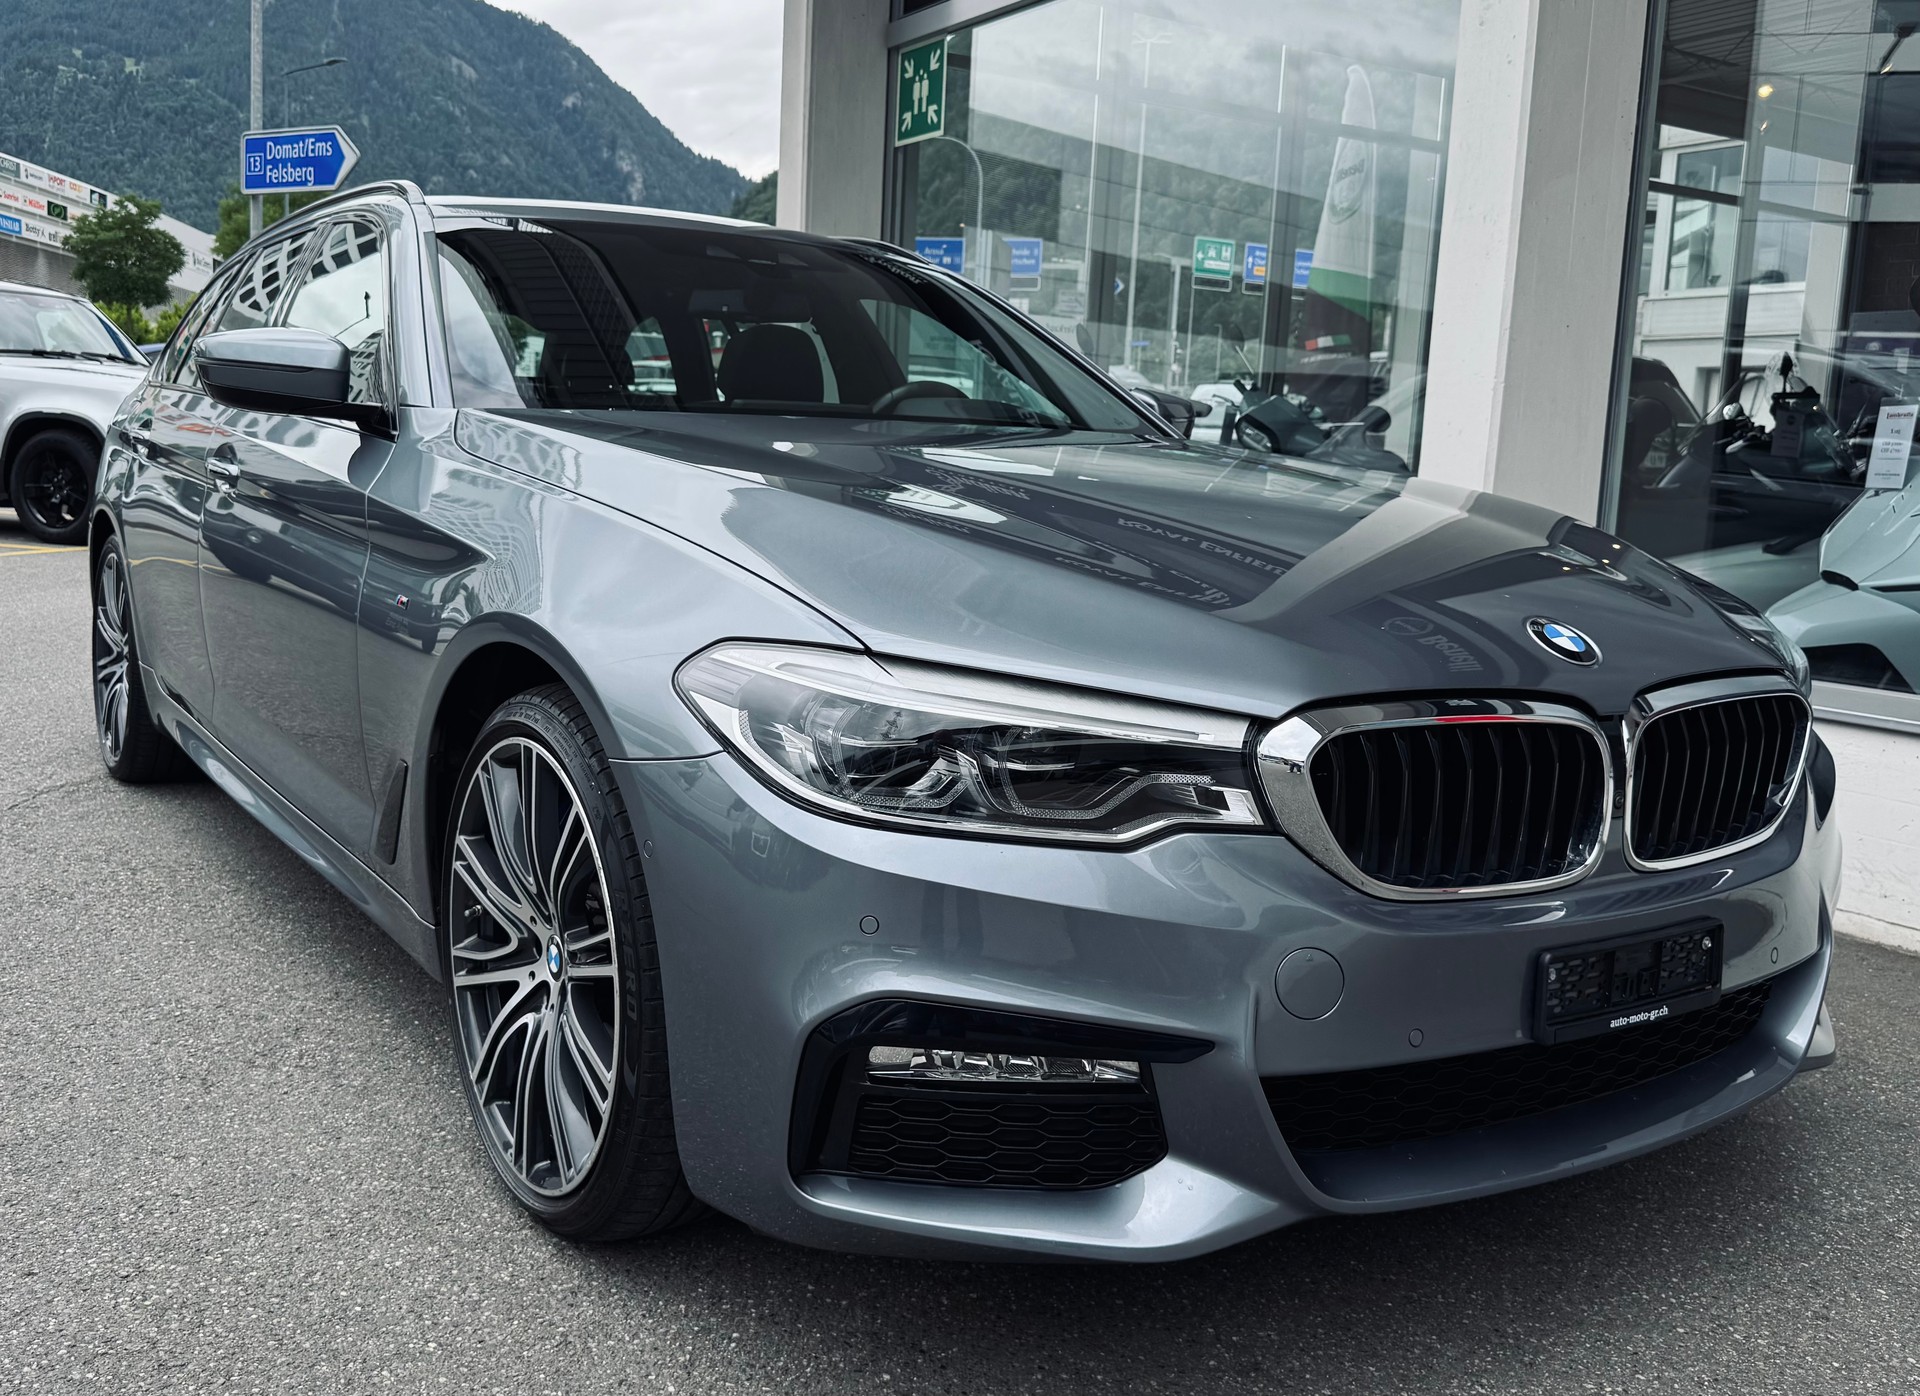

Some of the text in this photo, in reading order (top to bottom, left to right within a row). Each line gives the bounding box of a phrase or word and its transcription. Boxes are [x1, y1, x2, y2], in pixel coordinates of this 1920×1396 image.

[266, 138, 332, 160] Domat/Ems
[249, 156, 261, 172] 13
[266, 163, 314, 186] Felsberg
[1609, 1005, 1669, 1028] auto-moto-gr.ch
